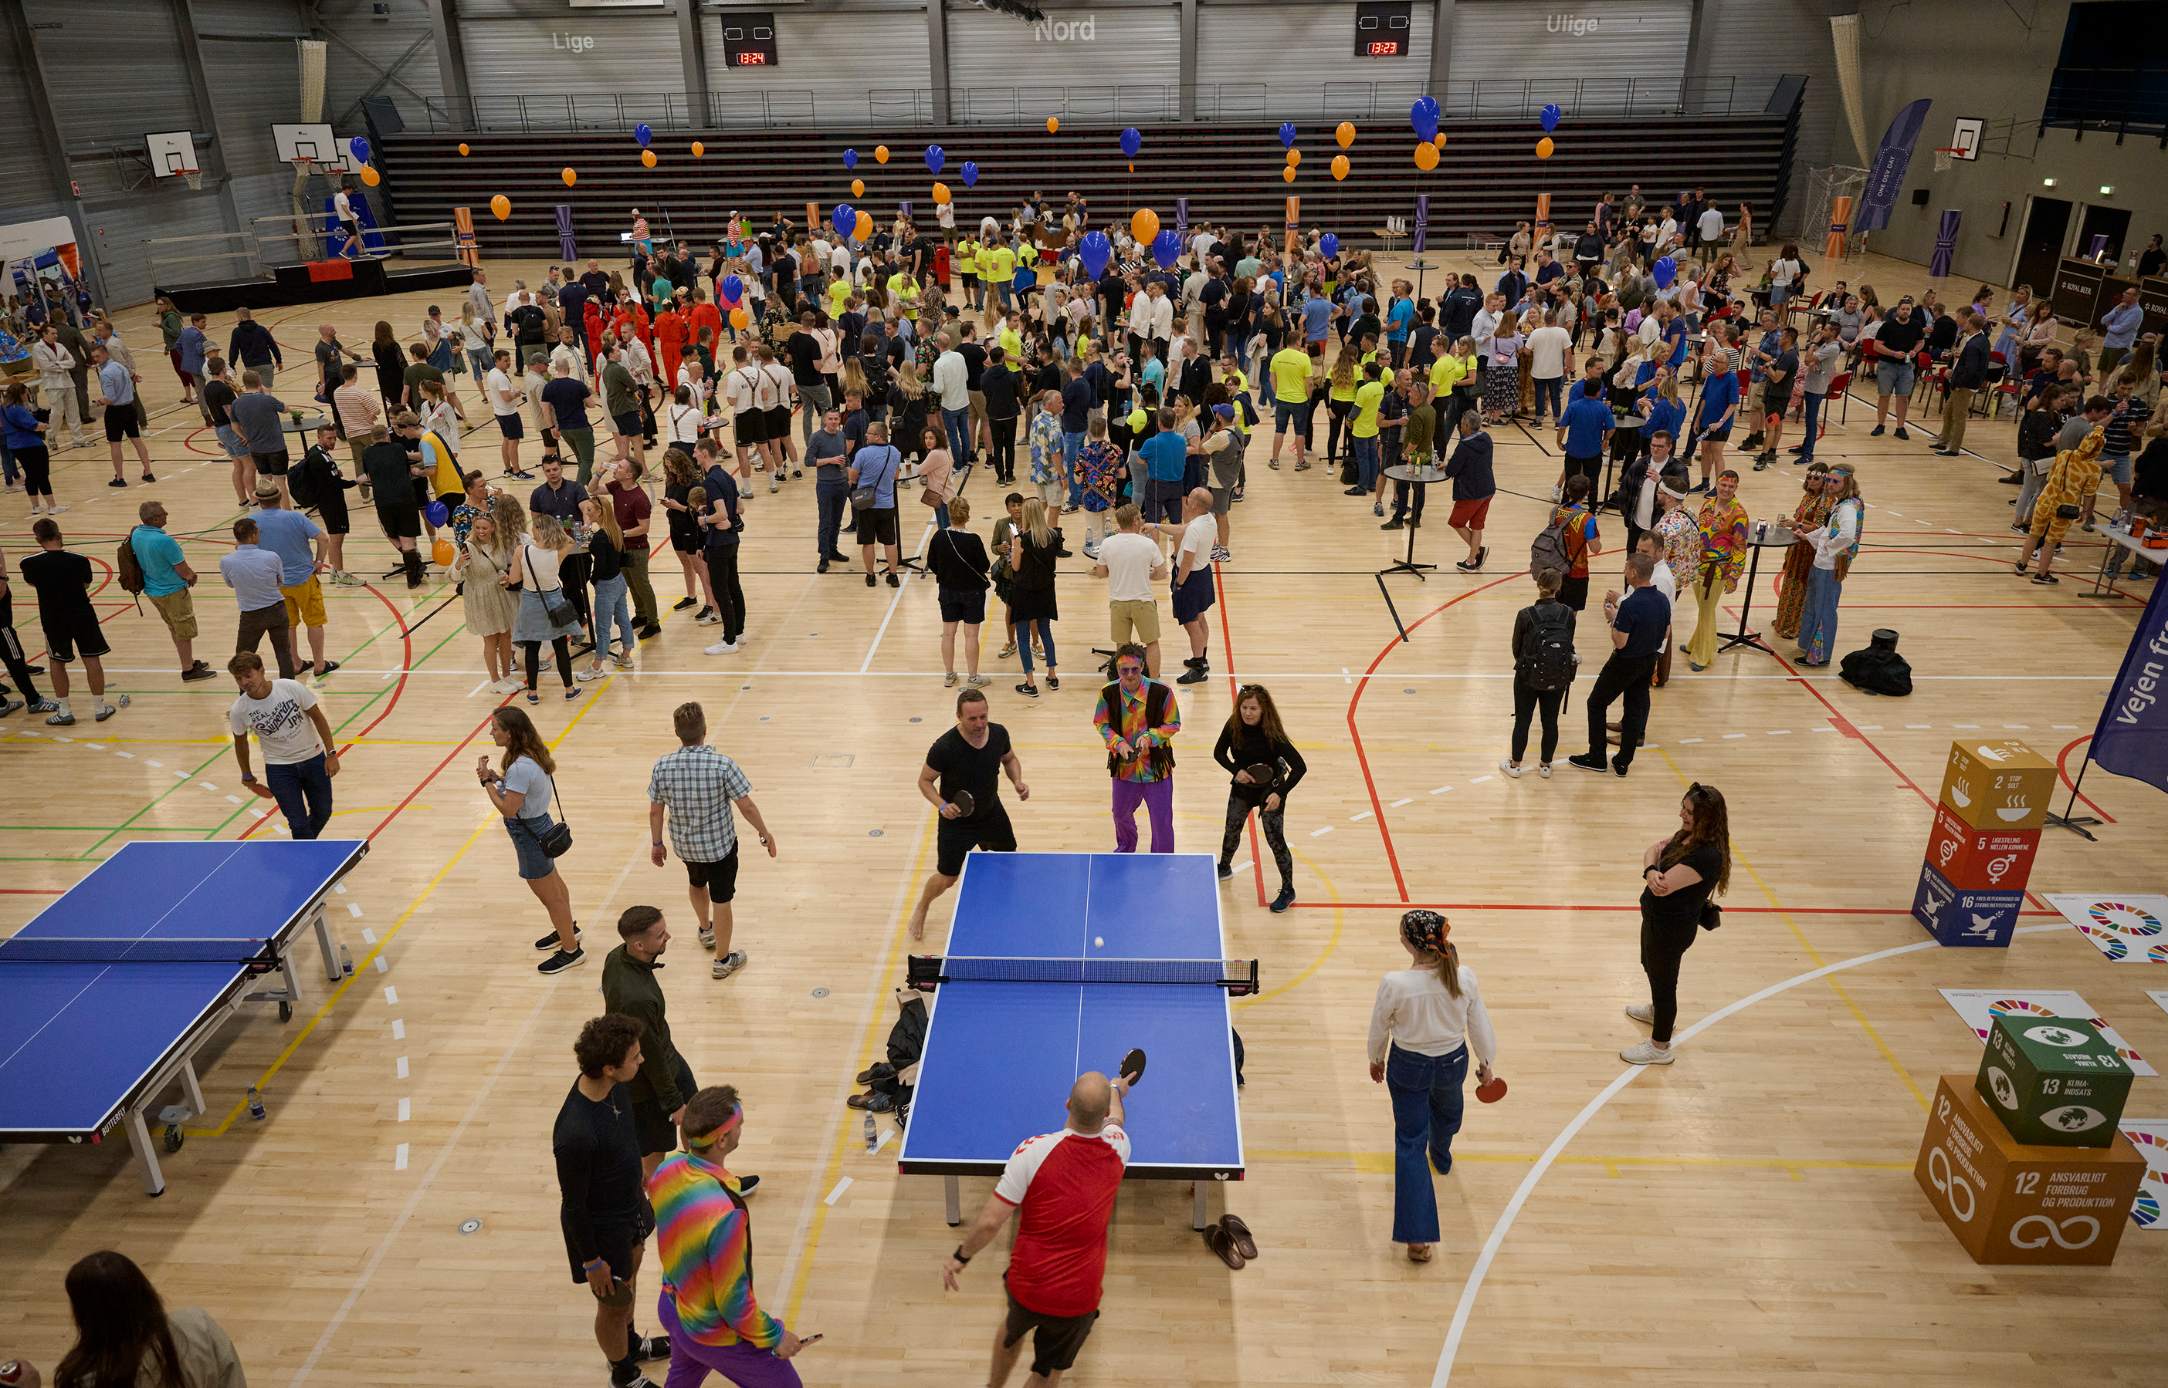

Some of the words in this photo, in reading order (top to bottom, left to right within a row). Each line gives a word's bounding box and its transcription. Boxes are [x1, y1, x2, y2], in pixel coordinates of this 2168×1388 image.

[1035, 15, 1095, 41] Nord
[1547, 15, 1598, 36] Ulige
[552, 32, 594, 53] Lige
[1372, 42, 1396, 53] 13:23
[740, 53, 764, 64] 13:24
[2067, 282, 2081, 293] ROYAL
[2116, 661, 2164, 724] Vejen
[2150, 621, 2168, 655] fr
[256, 699, 300, 736] Superdry
[1952, 752, 1960, 764] 2
[1994, 776, 2004, 789] 2
[1938, 810, 1944, 824] 5
[1978, 837, 1987, 850] 5
[1962, 896, 1974, 908] 16
[1992, 1030, 2003, 1050] 13
[2097, 1055, 2120, 1068] 13
[2042, 1079, 2060, 1095] 13
[102, 1106, 126, 1136] BUTTERFLY
[1938, 1094, 1951, 1126] 12
[1953, 1112, 1984, 1154] ANSVARLIGT
[2016, 1172, 2040, 1194] 12
[2050, 1172, 2107, 1182] ANSVARLIGT
[2046, 1184, 2089, 1194] FORBRUG
[2042, 1198, 2055, 1208] OG
[2056, 1198, 2116, 1208] PRODUKTION
